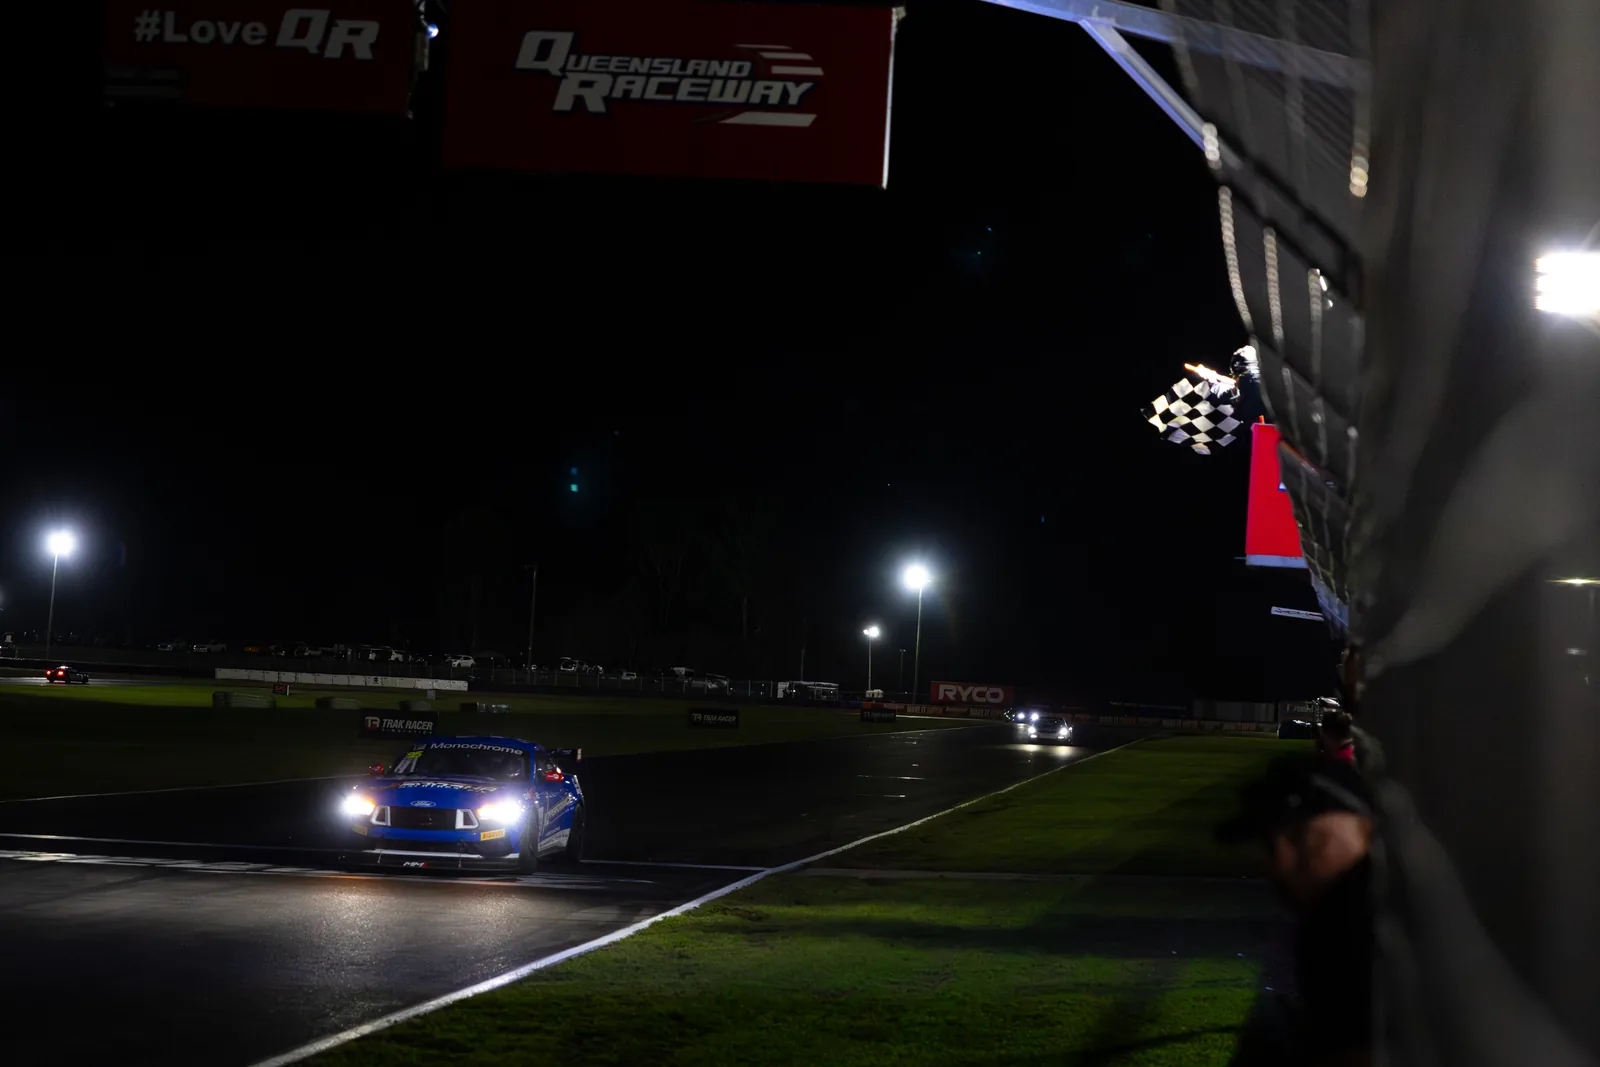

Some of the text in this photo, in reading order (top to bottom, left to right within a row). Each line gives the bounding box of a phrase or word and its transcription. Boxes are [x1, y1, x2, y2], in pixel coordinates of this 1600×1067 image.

[132, 8, 381, 60] #Love QR
[515, 29, 753, 77] QUEENSLAND
[551, 72, 815, 113] RACEWAY
[938, 684, 1005, 702] RYCO
[382, 718, 405, 729] TRAK
[405, 720, 434, 730] RACER
[430, 743, 524, 756] Monochrome
